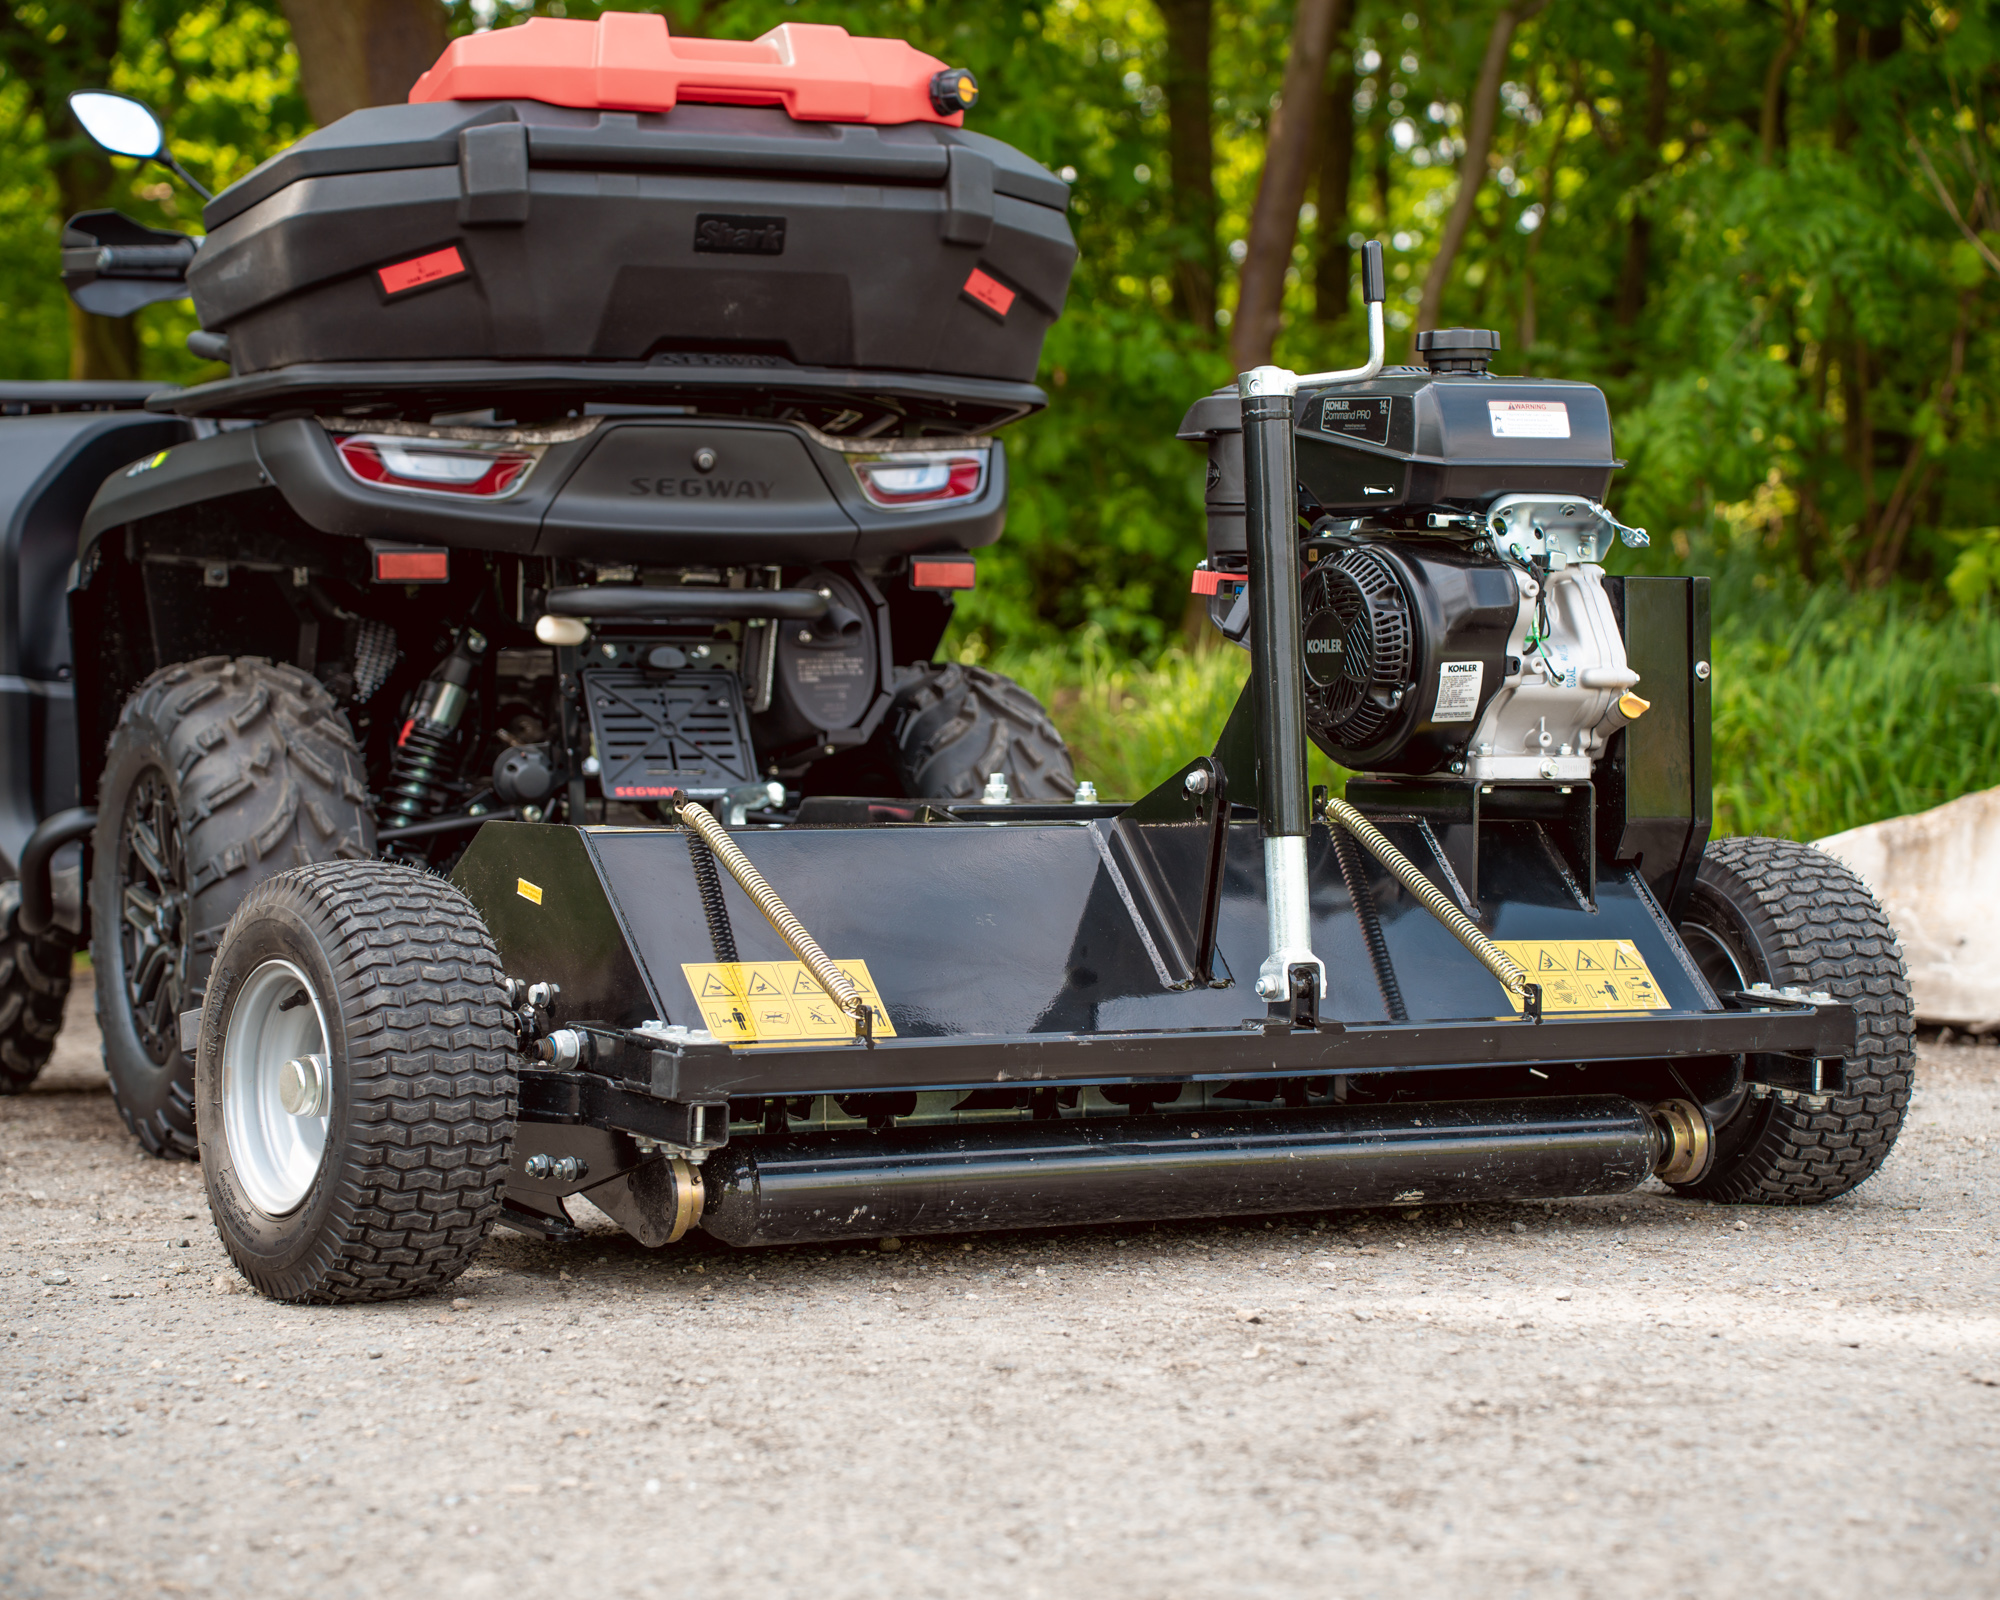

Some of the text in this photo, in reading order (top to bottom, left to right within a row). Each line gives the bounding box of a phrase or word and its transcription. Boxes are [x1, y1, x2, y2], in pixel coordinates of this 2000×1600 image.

[697, 220, 783, 249] Shark
[1325, 401, 1350, 410] KOHLER
[1380, 400, 1387, 409] 14
[1324, 411, 1355, 420] Command
[1356, 409, 1371, 419] PRO
[629, 478, 775, 498] SEGWAY
[1307, 639, 1342, 653] KOHLER
[1448, 664, 1477, 673] KOHLER
[614, 786, 678, 797] SEGWAY
